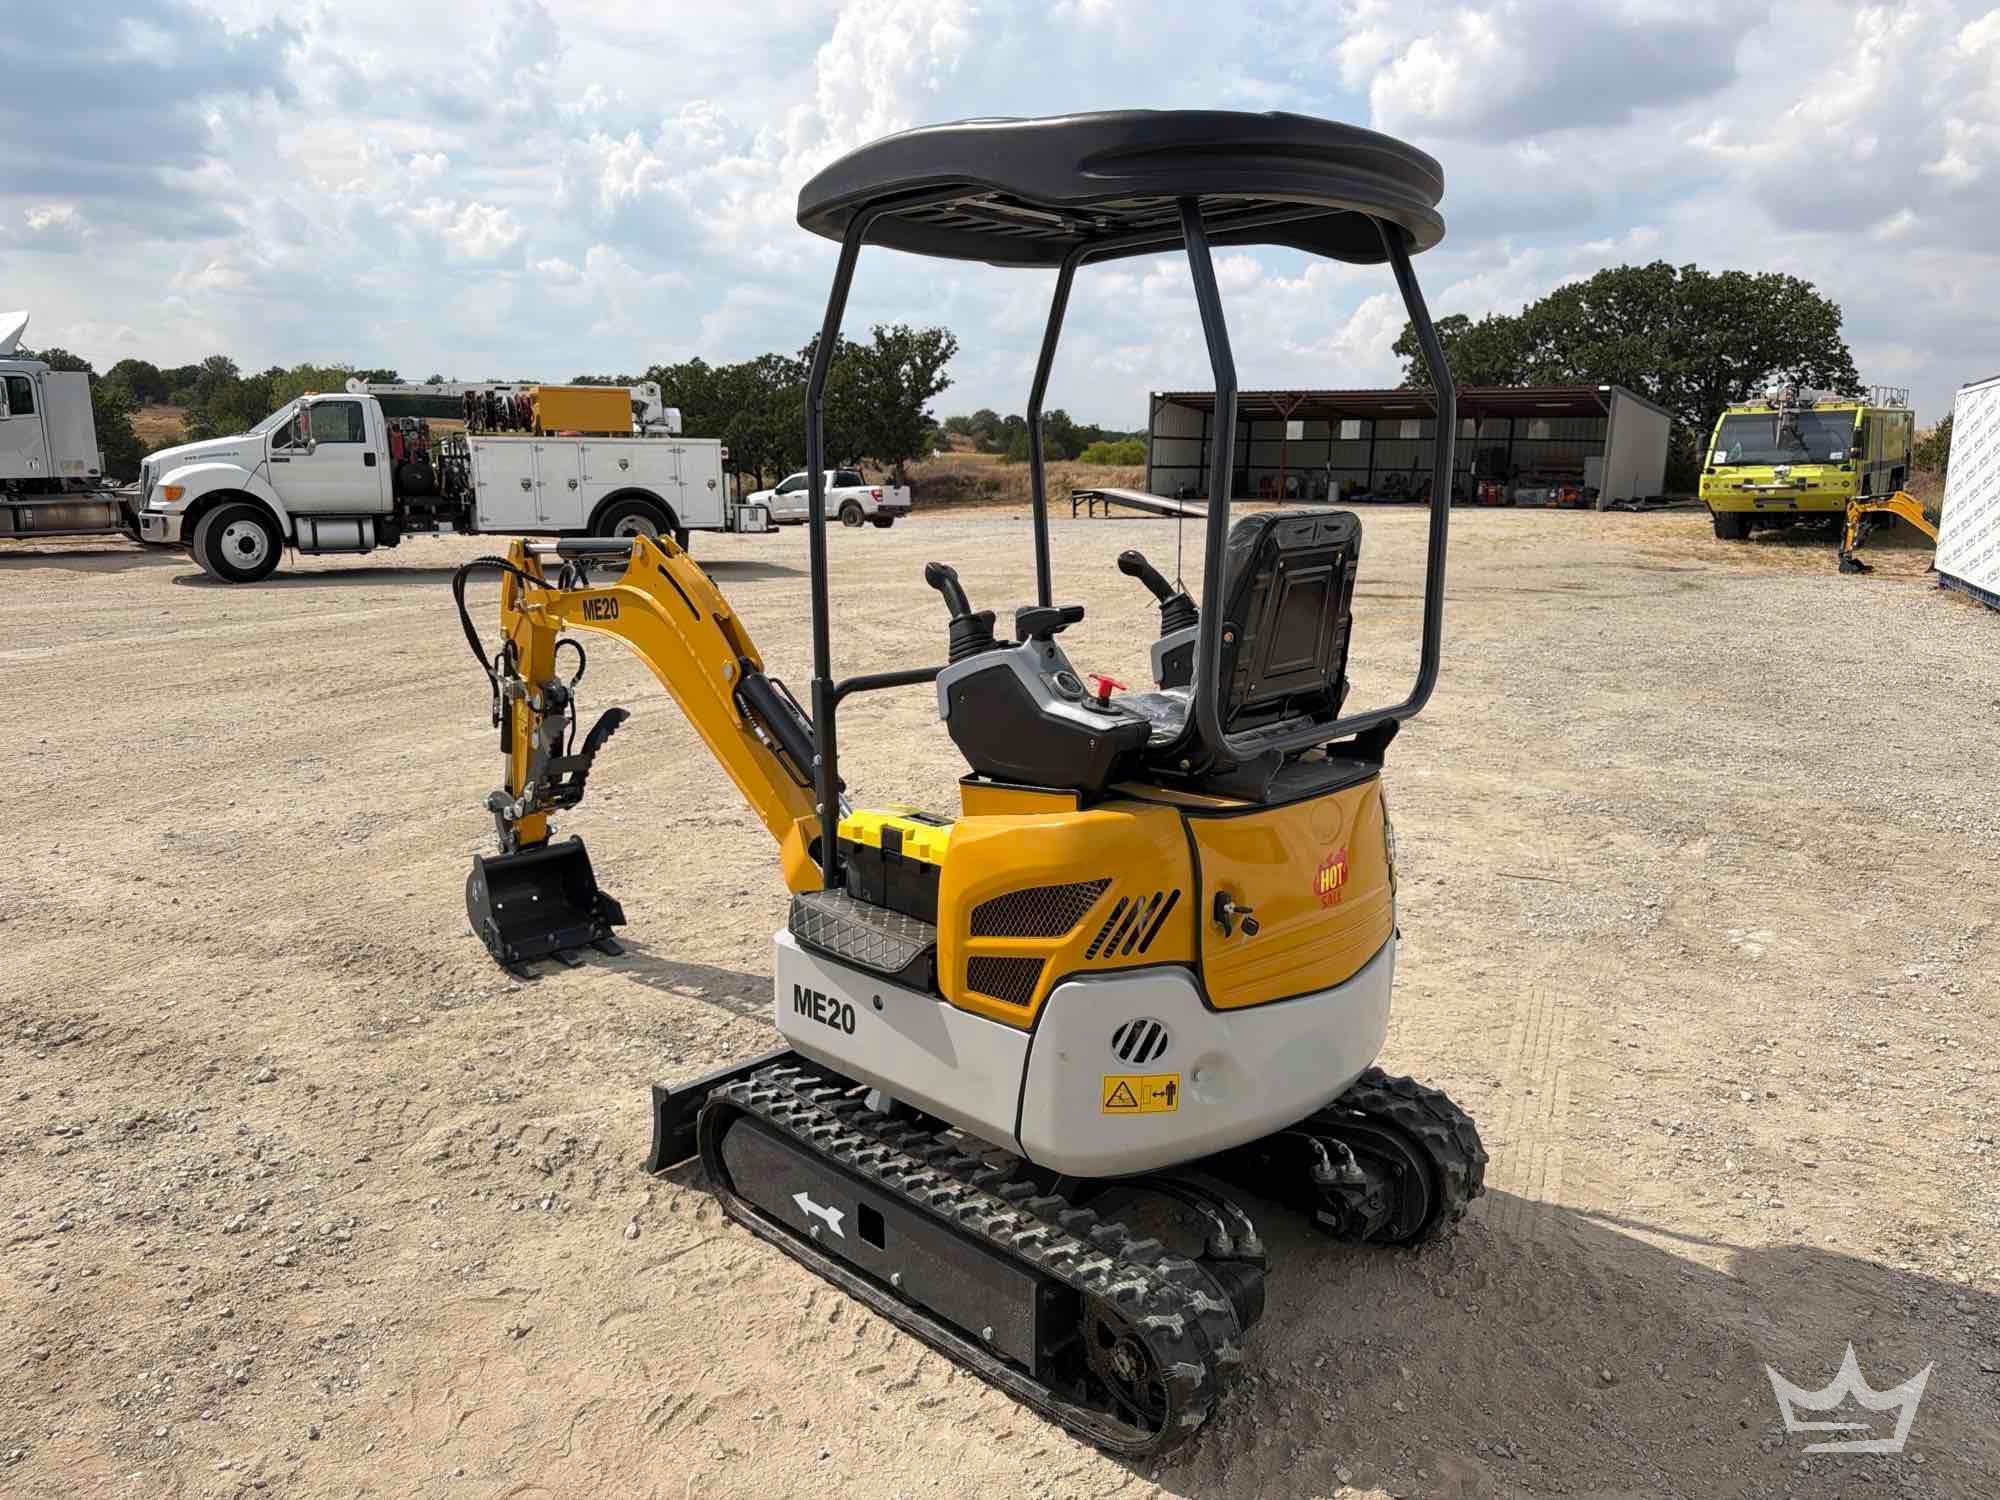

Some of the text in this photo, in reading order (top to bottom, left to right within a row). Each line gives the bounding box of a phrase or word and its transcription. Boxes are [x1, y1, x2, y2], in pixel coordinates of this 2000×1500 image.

[582, 597, 620, 622] ME20
[1320, 862, 1344, 893] HOT
[793, 983, 856, 1035] ME20
